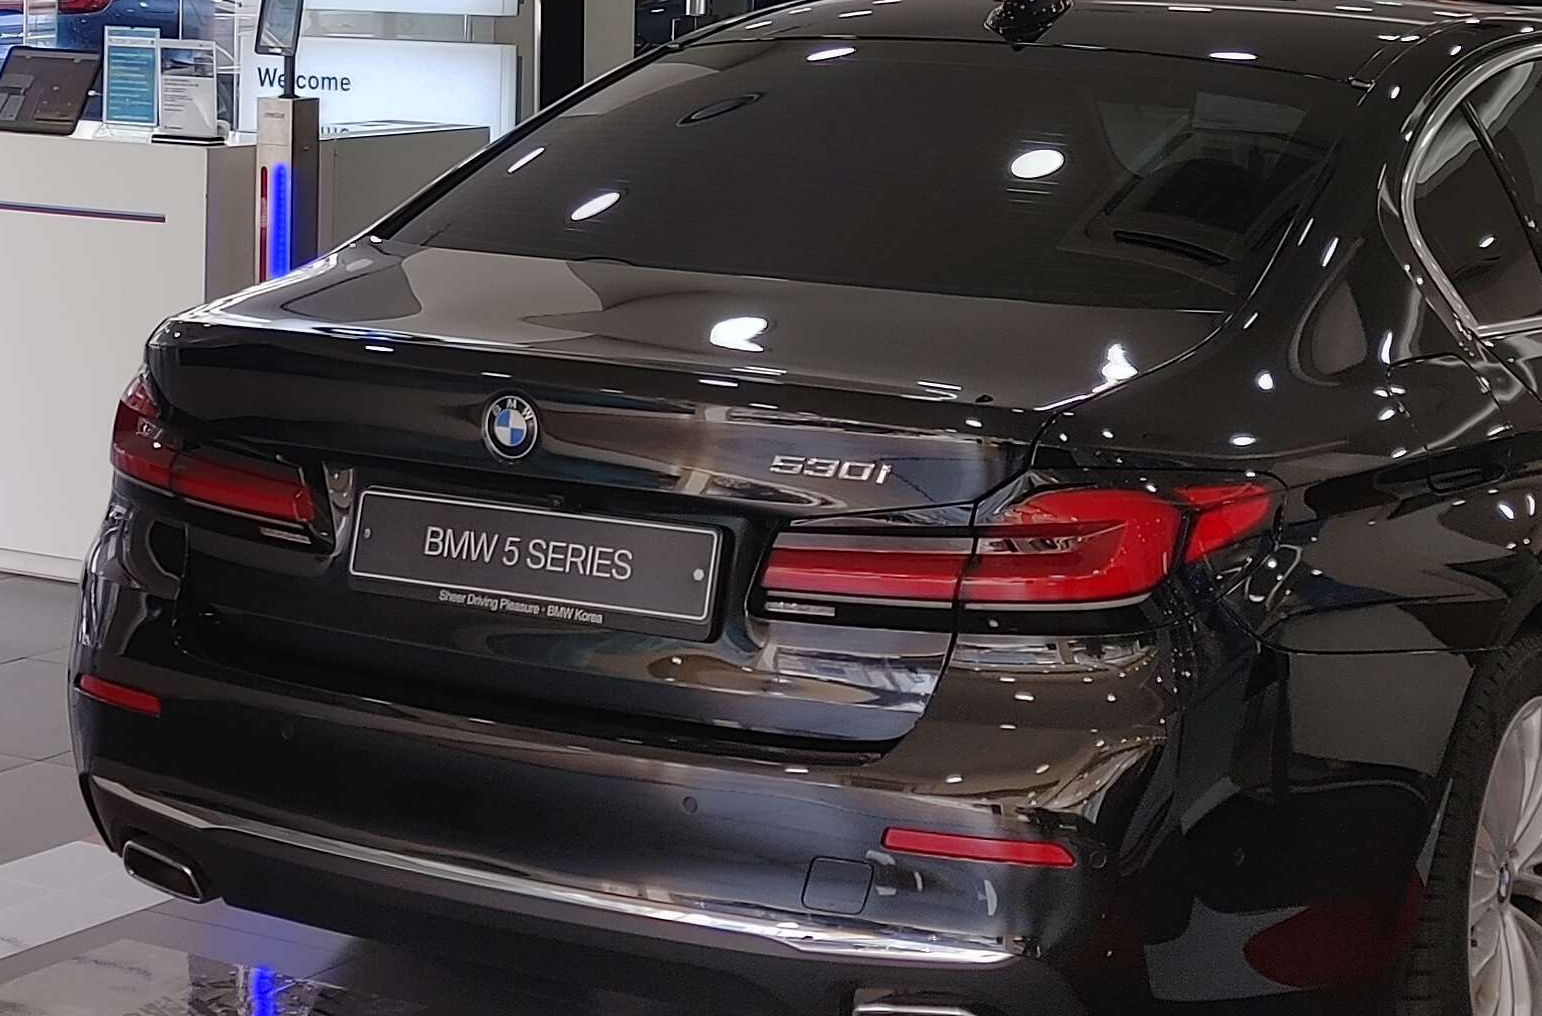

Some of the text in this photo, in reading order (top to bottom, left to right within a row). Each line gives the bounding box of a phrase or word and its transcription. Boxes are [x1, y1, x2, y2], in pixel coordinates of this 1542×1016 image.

[257, 67, 352, 92] Wecome
[492, 399, 534, 421] BMW
[769, 455, 892, 485] 530i
[424, 526, 633, 581] BMW 5 SERIES
[438, 589, 603, 624] Sheer Driving Pleasure BMW Korea
